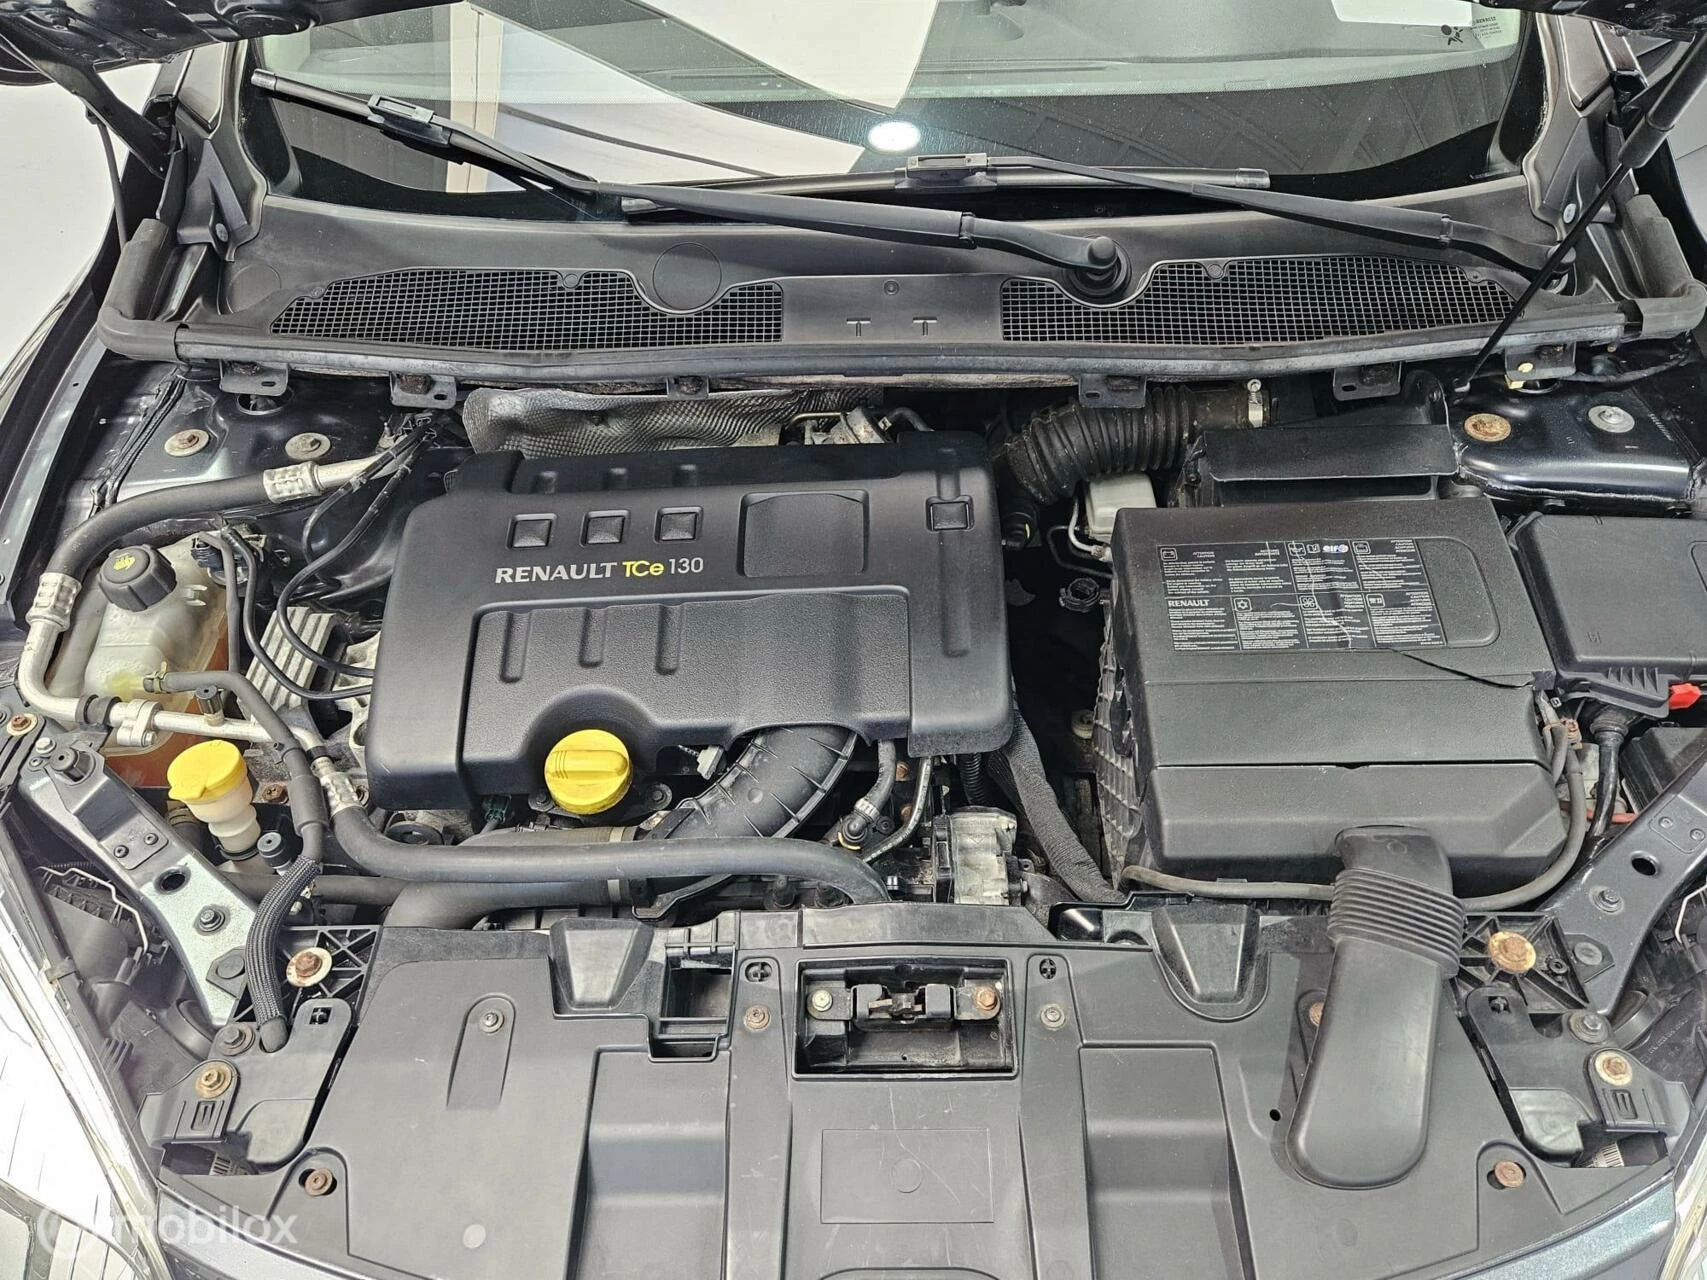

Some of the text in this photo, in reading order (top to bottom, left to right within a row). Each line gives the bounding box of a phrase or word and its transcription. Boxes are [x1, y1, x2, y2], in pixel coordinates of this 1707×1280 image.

[495, 557, 704, 584] RENAULT TCe 130
[1168, 599, 1210, 607] RENAULT
